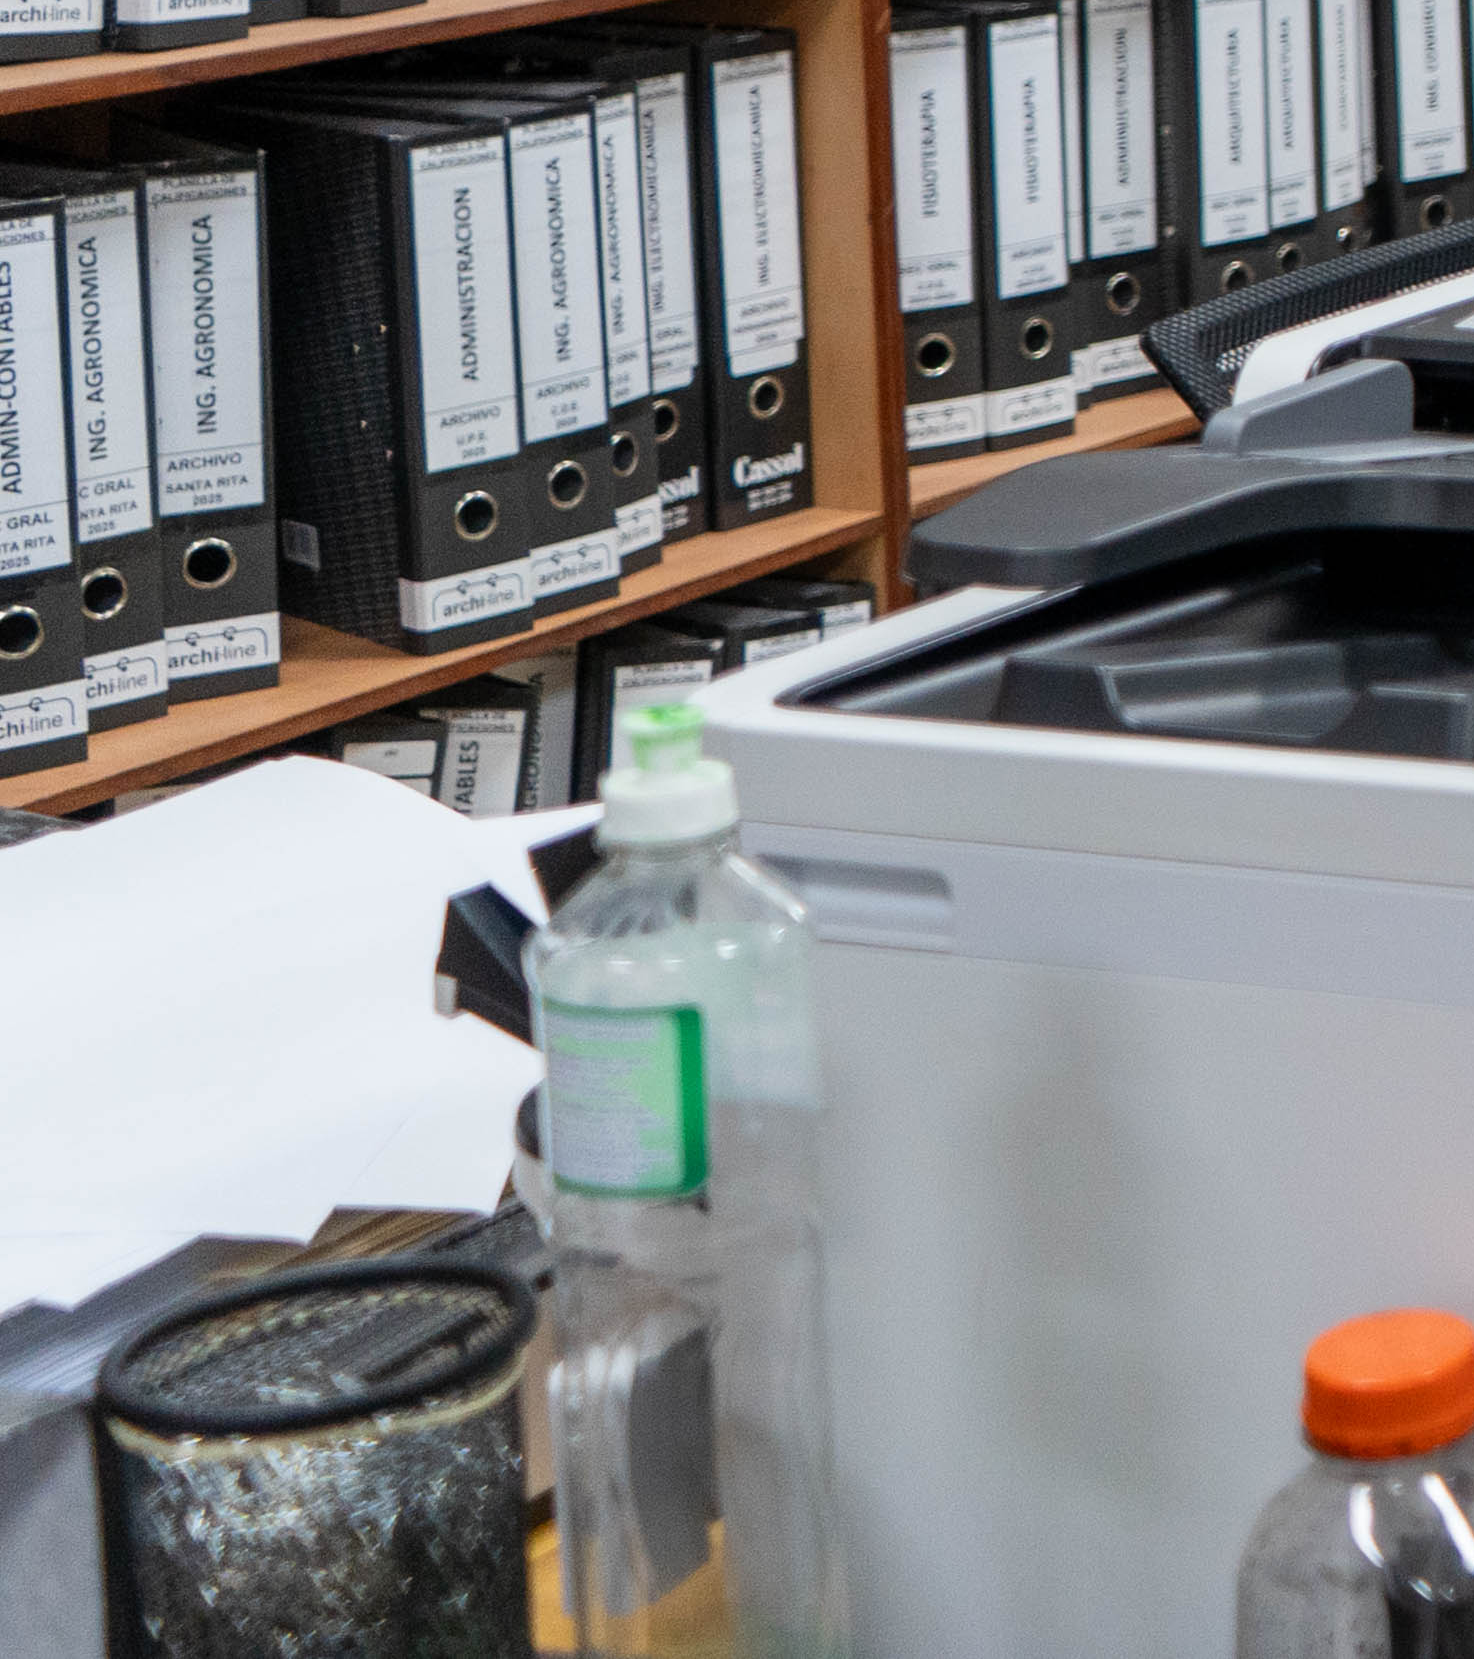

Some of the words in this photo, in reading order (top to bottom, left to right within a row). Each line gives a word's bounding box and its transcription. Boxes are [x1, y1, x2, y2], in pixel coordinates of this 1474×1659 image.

[0, 1, 81, 24] archi-line
[603, 134, 623, 287] AGRONOMICA
[546, 156, 570, 311] AGRONOMICA
[193, 213, 216, 372] AGRONOMICA
[453, 185, 480, 383] ADMINISTRACION
[79, 236, 104, 395] AGRONOMICA
[612, 294, 628, 336] ING.
[555, 318, 573, 363] ING.
[196, 379, 218, 435] ING.
[88, 404, 108, 462] ING.
[167, 452, 242, 473] ARCHIVO
[94, 478, 136, 494] GRAL
[165, 477, 212, 494] SANTA
[216, 474, 248, 486] RITA
[7, 511, 54, 531] GRAL
[109, 500, 138, 515] RITA
[24, 534, 56, 550] RITA
[442, 587, 515, 620] archi-line
[168, 639, 258, 671] archi-line
